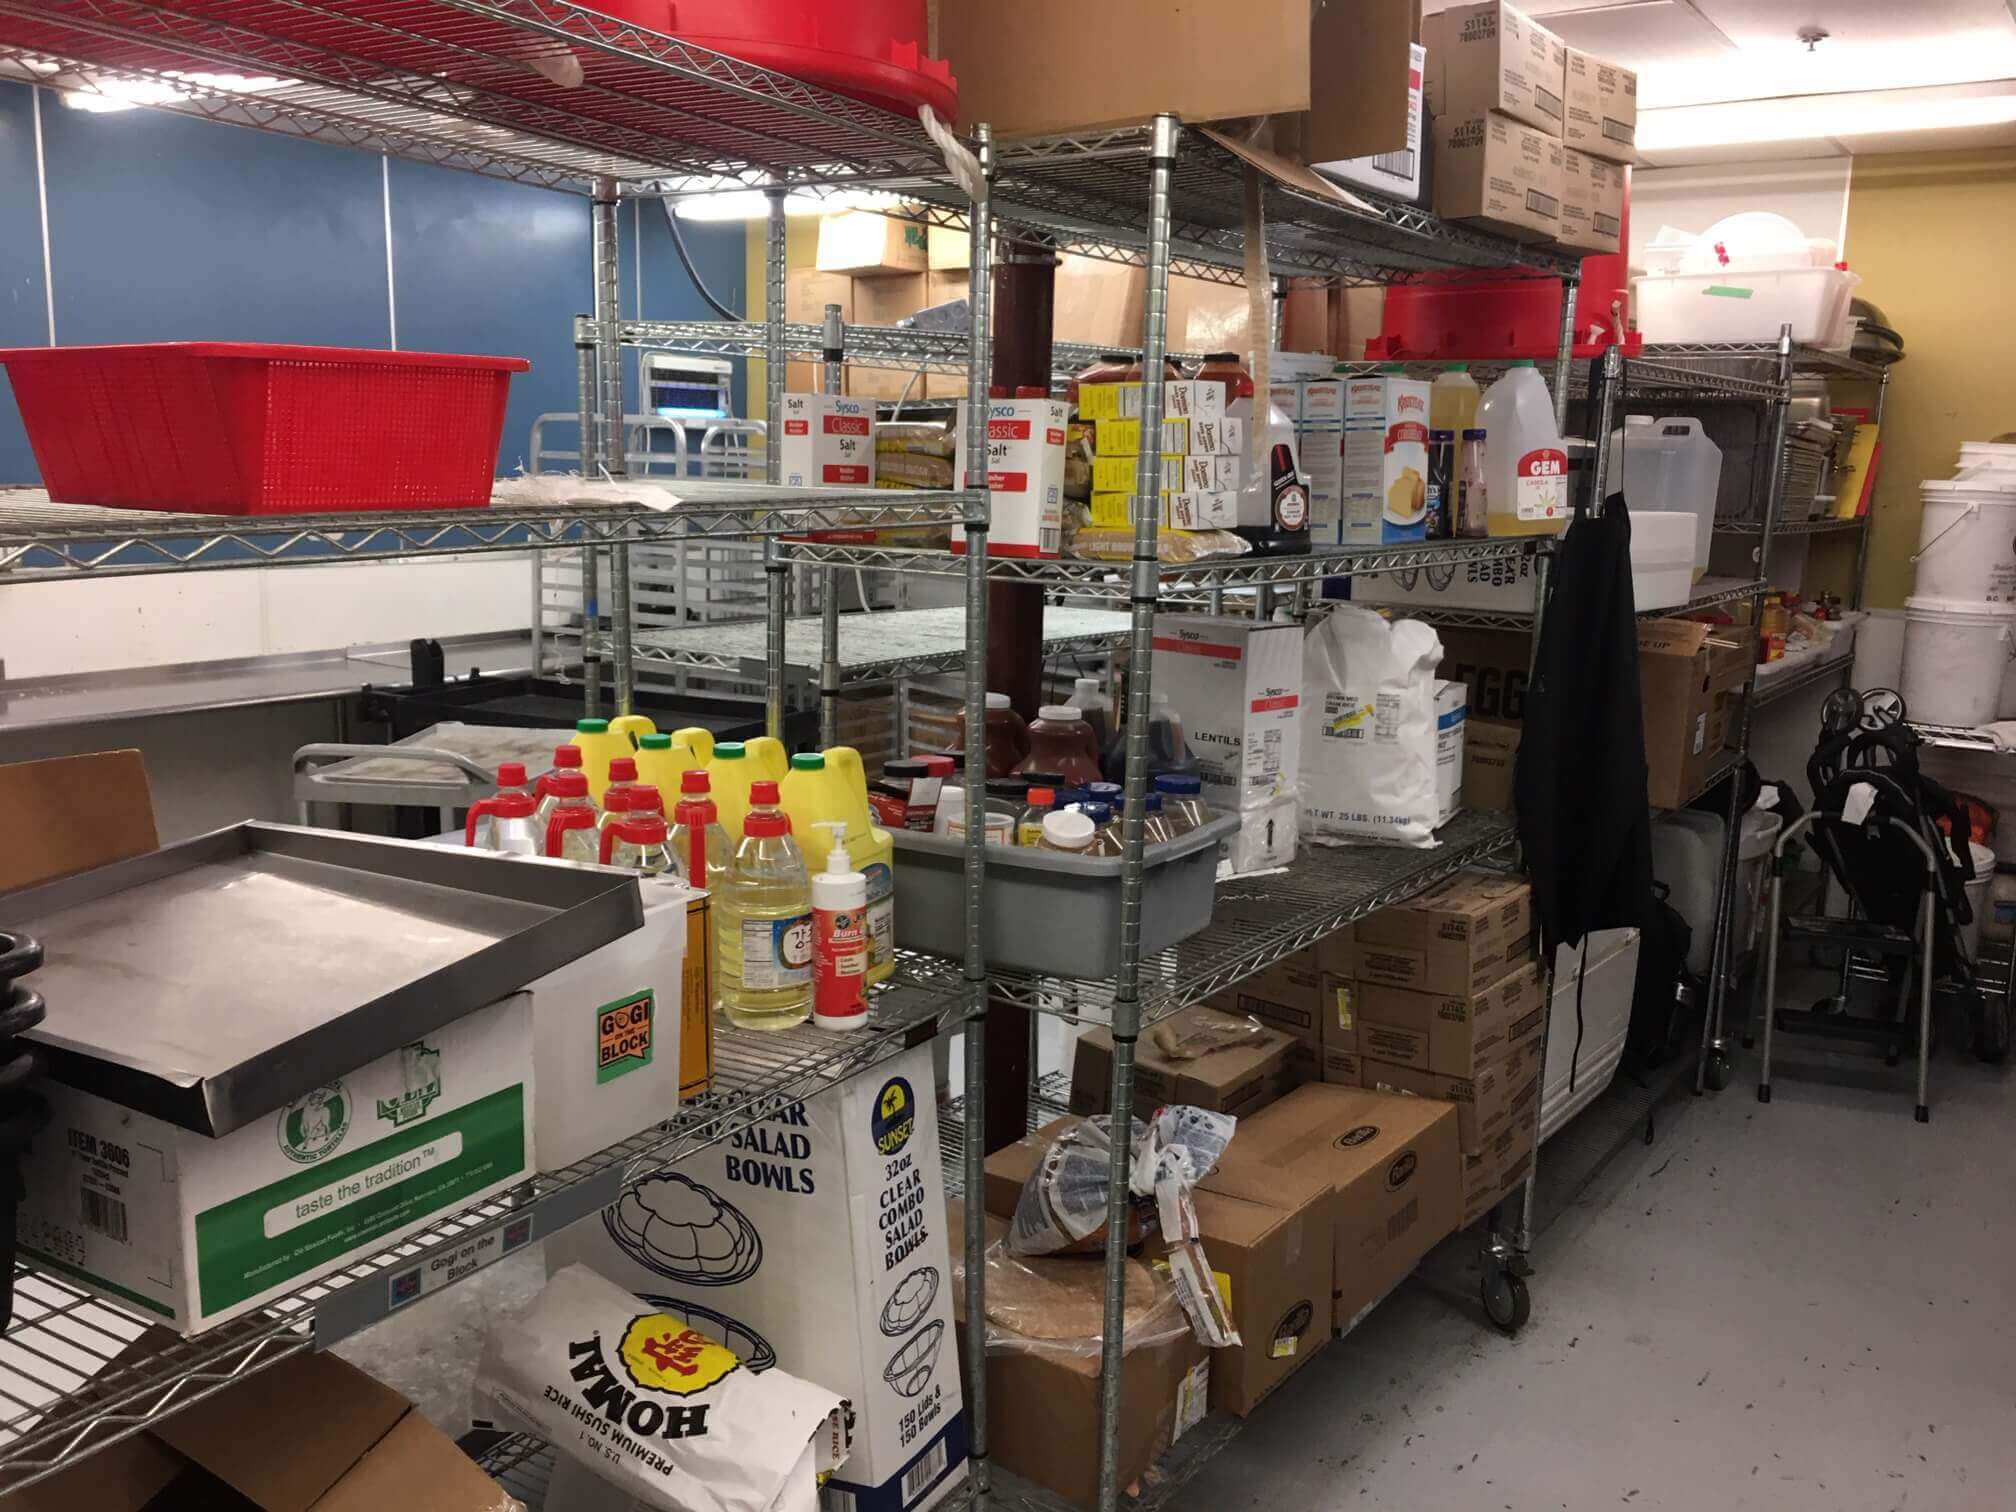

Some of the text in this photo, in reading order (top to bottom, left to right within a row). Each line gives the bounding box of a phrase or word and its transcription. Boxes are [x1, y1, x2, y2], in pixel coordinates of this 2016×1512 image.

[788, 399, 803, 408] Salt
[835, 400, 859, 415] Sysco
[987, 406, 1015, 417] ysco
[1051, 406, 1063, 417] Salt
[840, 439, 856, 450] Salt
[988, 423, 1018, 438] assic
[1530, 460, 1561, 475] GEM
[1195, 731, 1241, 746] LENTILS
[1339, 812, 1350, 821] 25
[832, 929, 859, 938] Burn
[602, 1002, 649, 1035] GOGI
[602, 1031, 648, 1062] BLOCK
[67, 1128, 130, 1168] ITEM 3606
[731, 1121, 812, 1160] SALAD
[877, 1119, 914, 1157] SUNSET
[295, 1193, 334, 1219] taste
[337, 1183, 361, 1201] the
[364, 1155, 421, 1190] tradition
[725, 1154, 815, 1195] BOWLS
[879, 1168, 922, 1209] CLEAR
[878, 1186, 926, 1231] COMBO
[885, 1207, 924, 1250] SALAD
[431, 1236, 495, 1272] Gogi on the
[885, 1224, 929, 1271] BOWLS
[447, 1259, 478, 1281] Block
[899, 1383, 942, 1433] 150 Lids &
[899, 1402, 942, 1449] 150 Bowls
[542, 1384, 675, 1477] PREMIUM SUSHI RICE
[578, 1430, 621, 1465] U.S. NO. 1
